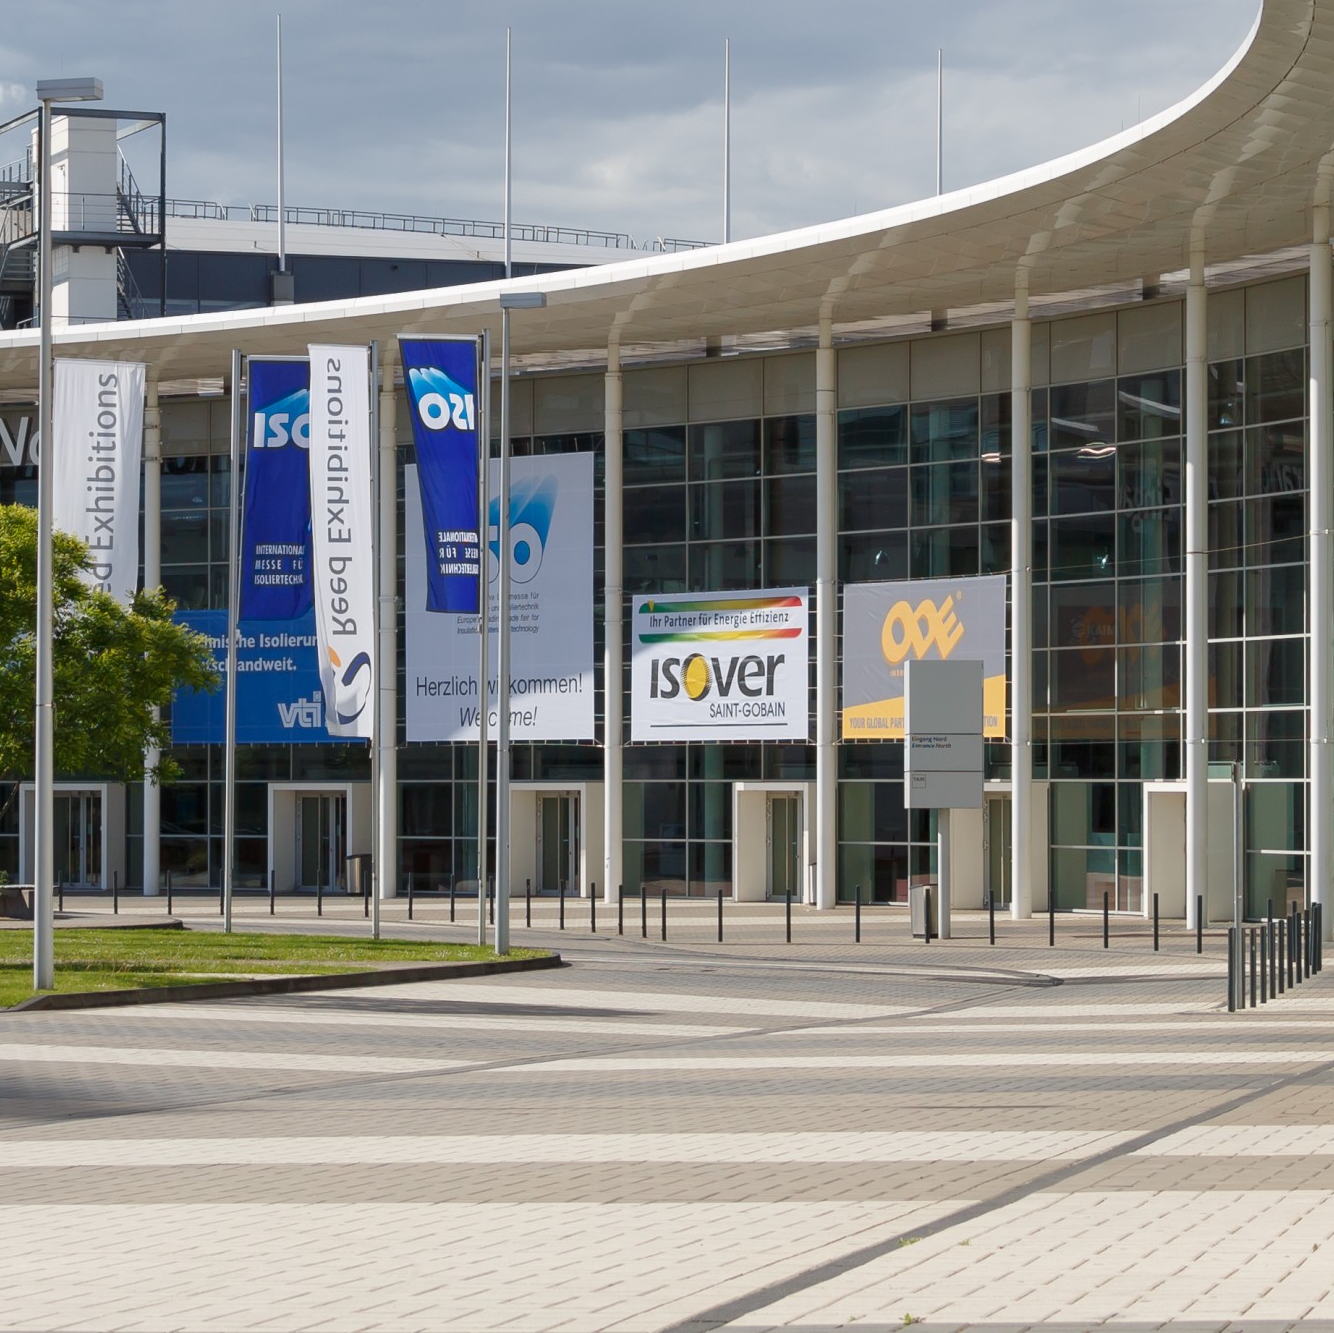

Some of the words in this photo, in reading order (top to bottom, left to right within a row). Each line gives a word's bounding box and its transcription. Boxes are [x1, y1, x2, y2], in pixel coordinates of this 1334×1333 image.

[85, 373, 118, 551] Exhibitions
[650, 615, 662, 628] Ihr
[664, 614, 696, 628] Partner
[698, 612, 711, 625] für
[714, 613, 747, 628] Energie
[750, 611, 789, 624] Effizienz
[416, 675, 478, 697] Herzlich
[709, 702, 786, 718] SAINT-GOBAIN
[850, 717, 866, 729] YOUR
[867, 717, 889, 729] GLOBAL
